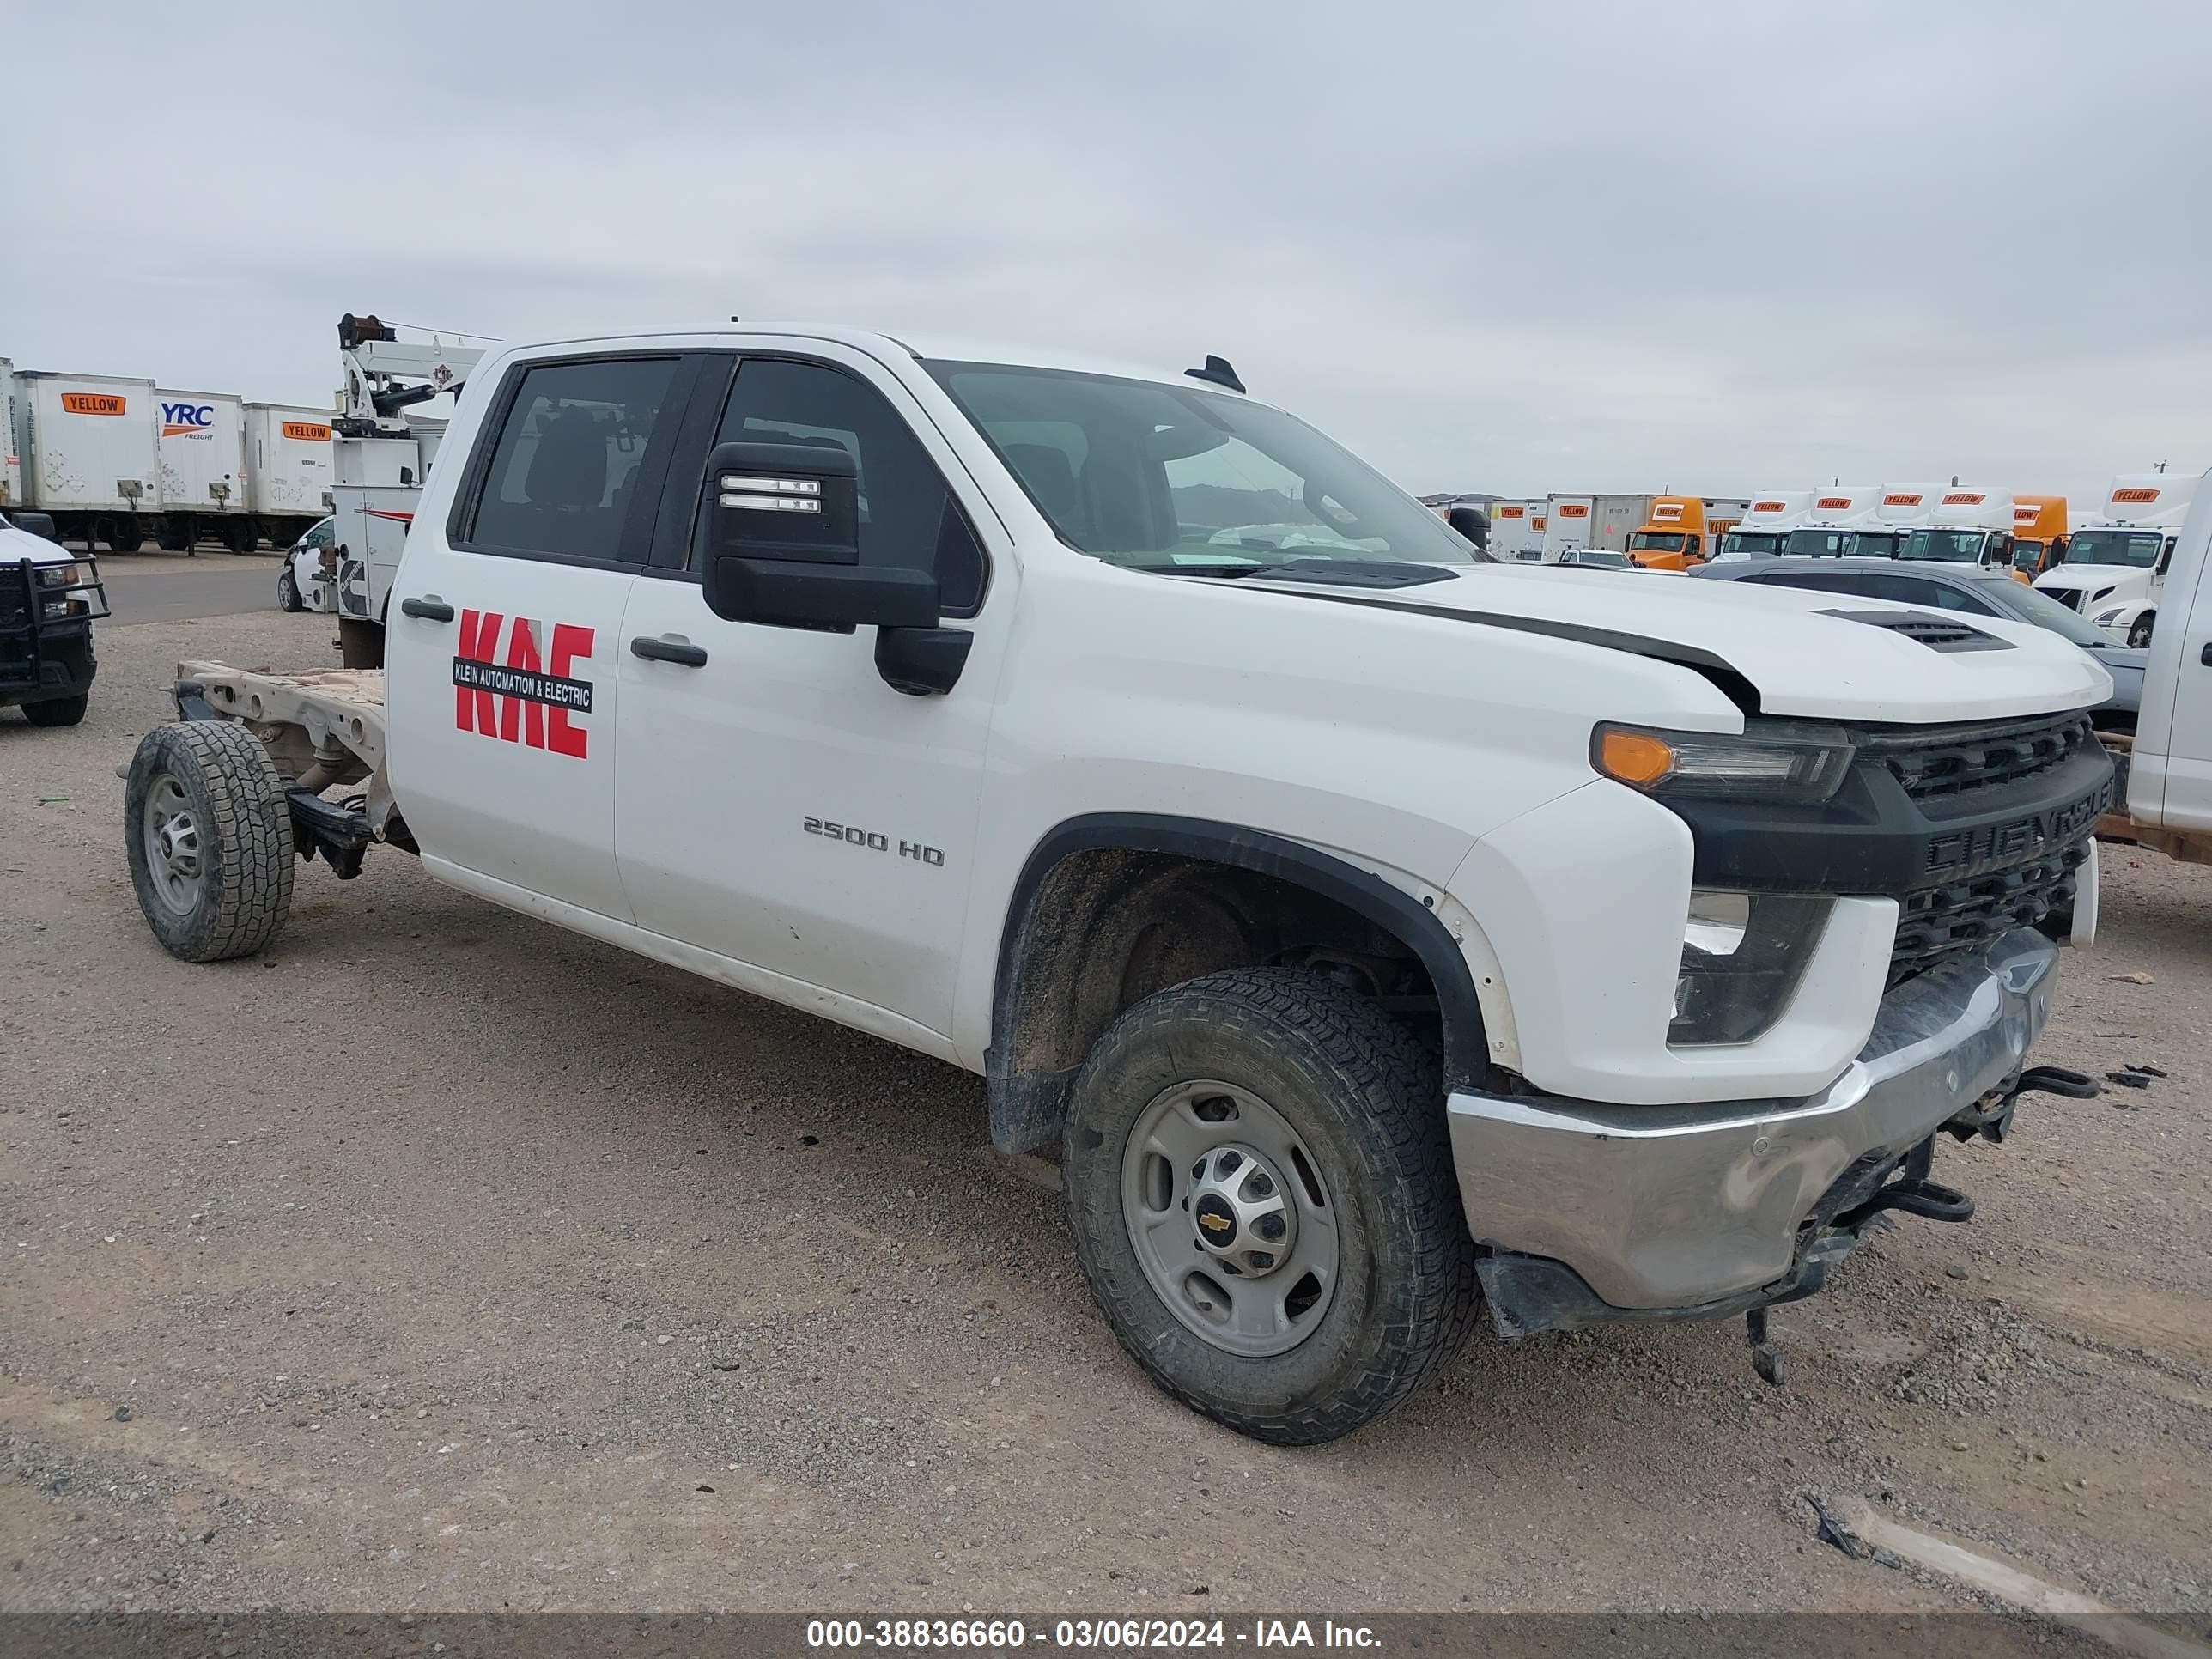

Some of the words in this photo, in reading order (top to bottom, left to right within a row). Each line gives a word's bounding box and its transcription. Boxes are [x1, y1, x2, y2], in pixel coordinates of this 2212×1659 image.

[70, 396, 118, 412] YELLOW
[161, 403, 214, 427] YRC
[185, 433, 214, 441] FREIGHT
[288, 426, 326, 439] YELLOW
[1887, 495, 1917, 504] YELLOW
[1947, 494, 1979, 503] YELLOW
[2116, 490, 2153, 501] YELLOW
[1757, 502, 1782, 511] YELLOW
[1820, 499, 1848, 507] YELLOW
[1534, 518, 1545, 529] YEL
[455, 663, 478, 684] KLEIN
[479, 670, 535, 696] AUTOMATION
[536, 679, 544, 697] &
[544, 682, 590, 707] ELECTRIC
[804, 816, 889, 852] 2500
[899, 838, 945, 867] HD
